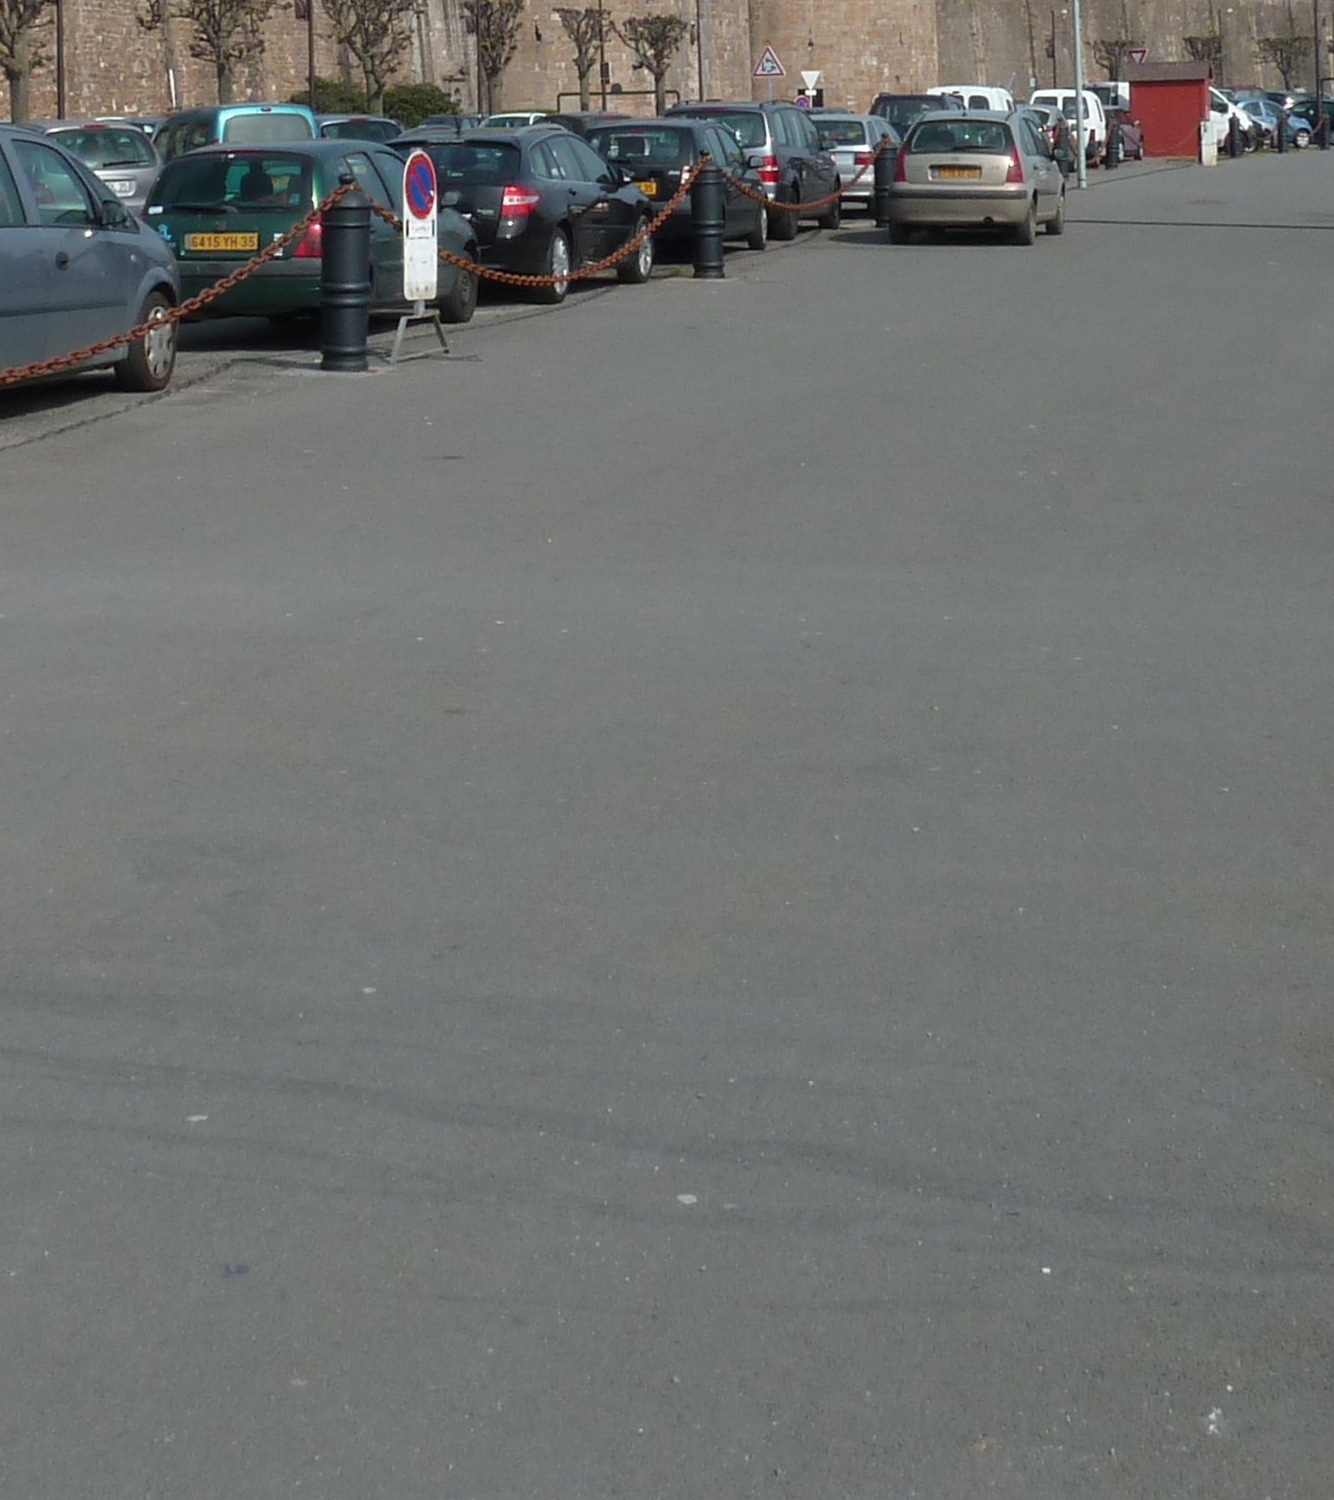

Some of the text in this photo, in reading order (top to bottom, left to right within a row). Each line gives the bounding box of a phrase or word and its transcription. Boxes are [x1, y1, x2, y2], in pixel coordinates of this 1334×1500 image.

[191, 236, 256, 248] 6415 YH 35
